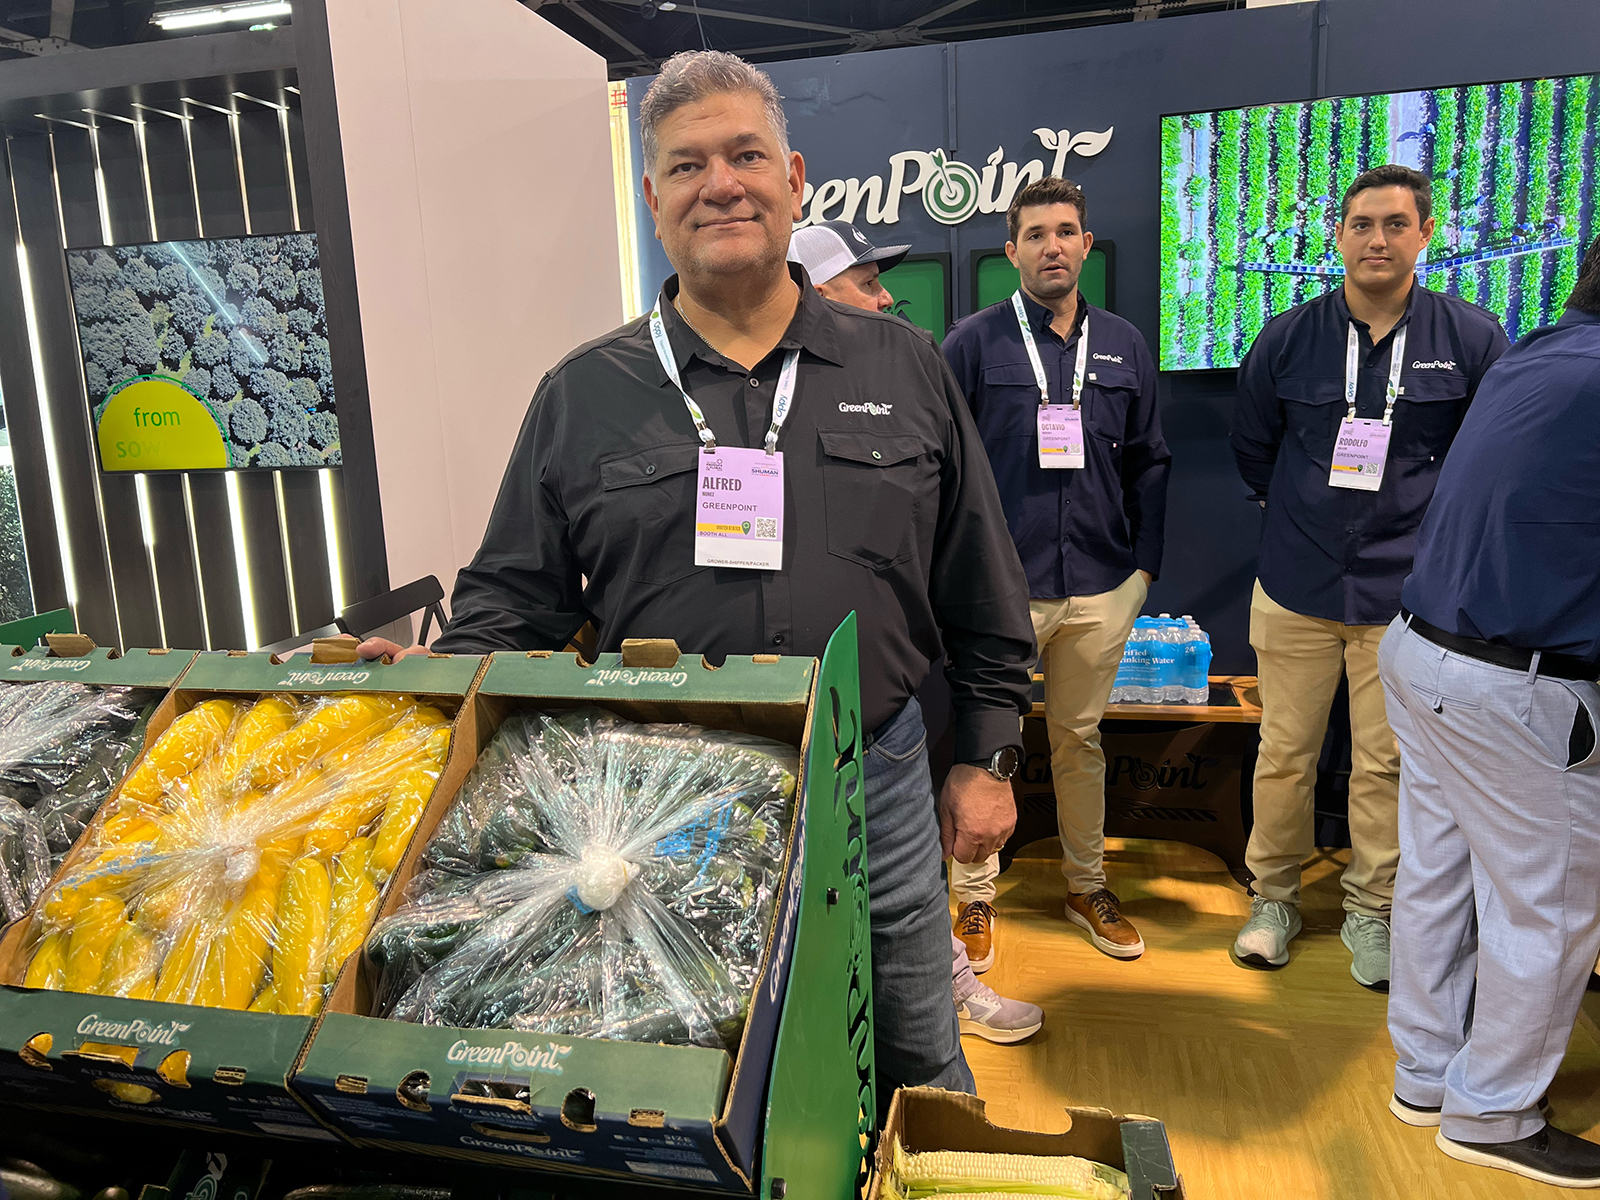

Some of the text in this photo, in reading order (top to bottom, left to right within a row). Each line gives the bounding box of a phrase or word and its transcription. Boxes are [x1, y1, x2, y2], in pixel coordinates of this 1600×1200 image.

[838, 401, 893, 415] GreenPoint
[133, 407, 181, 427] from
[1041, 423, 1065, 431] OCTAVIO
[1339, 437, 1368, 448] RODOLFO
[702, 476, 742, 491] ALFRED
[702, 501, 757, 512] GREENPOINT
[277, 671, 370, 686] GreenPoint
[586, 669, 688, 687] GreenPoint
[76, 1014, 191, 1045] GreenPoint
[446, 1039, 573, 1070] GreenPoint
[480, 1108, 542, 1123] BUSHEL
[459, 1135, 582, 1158] GreenPoint
